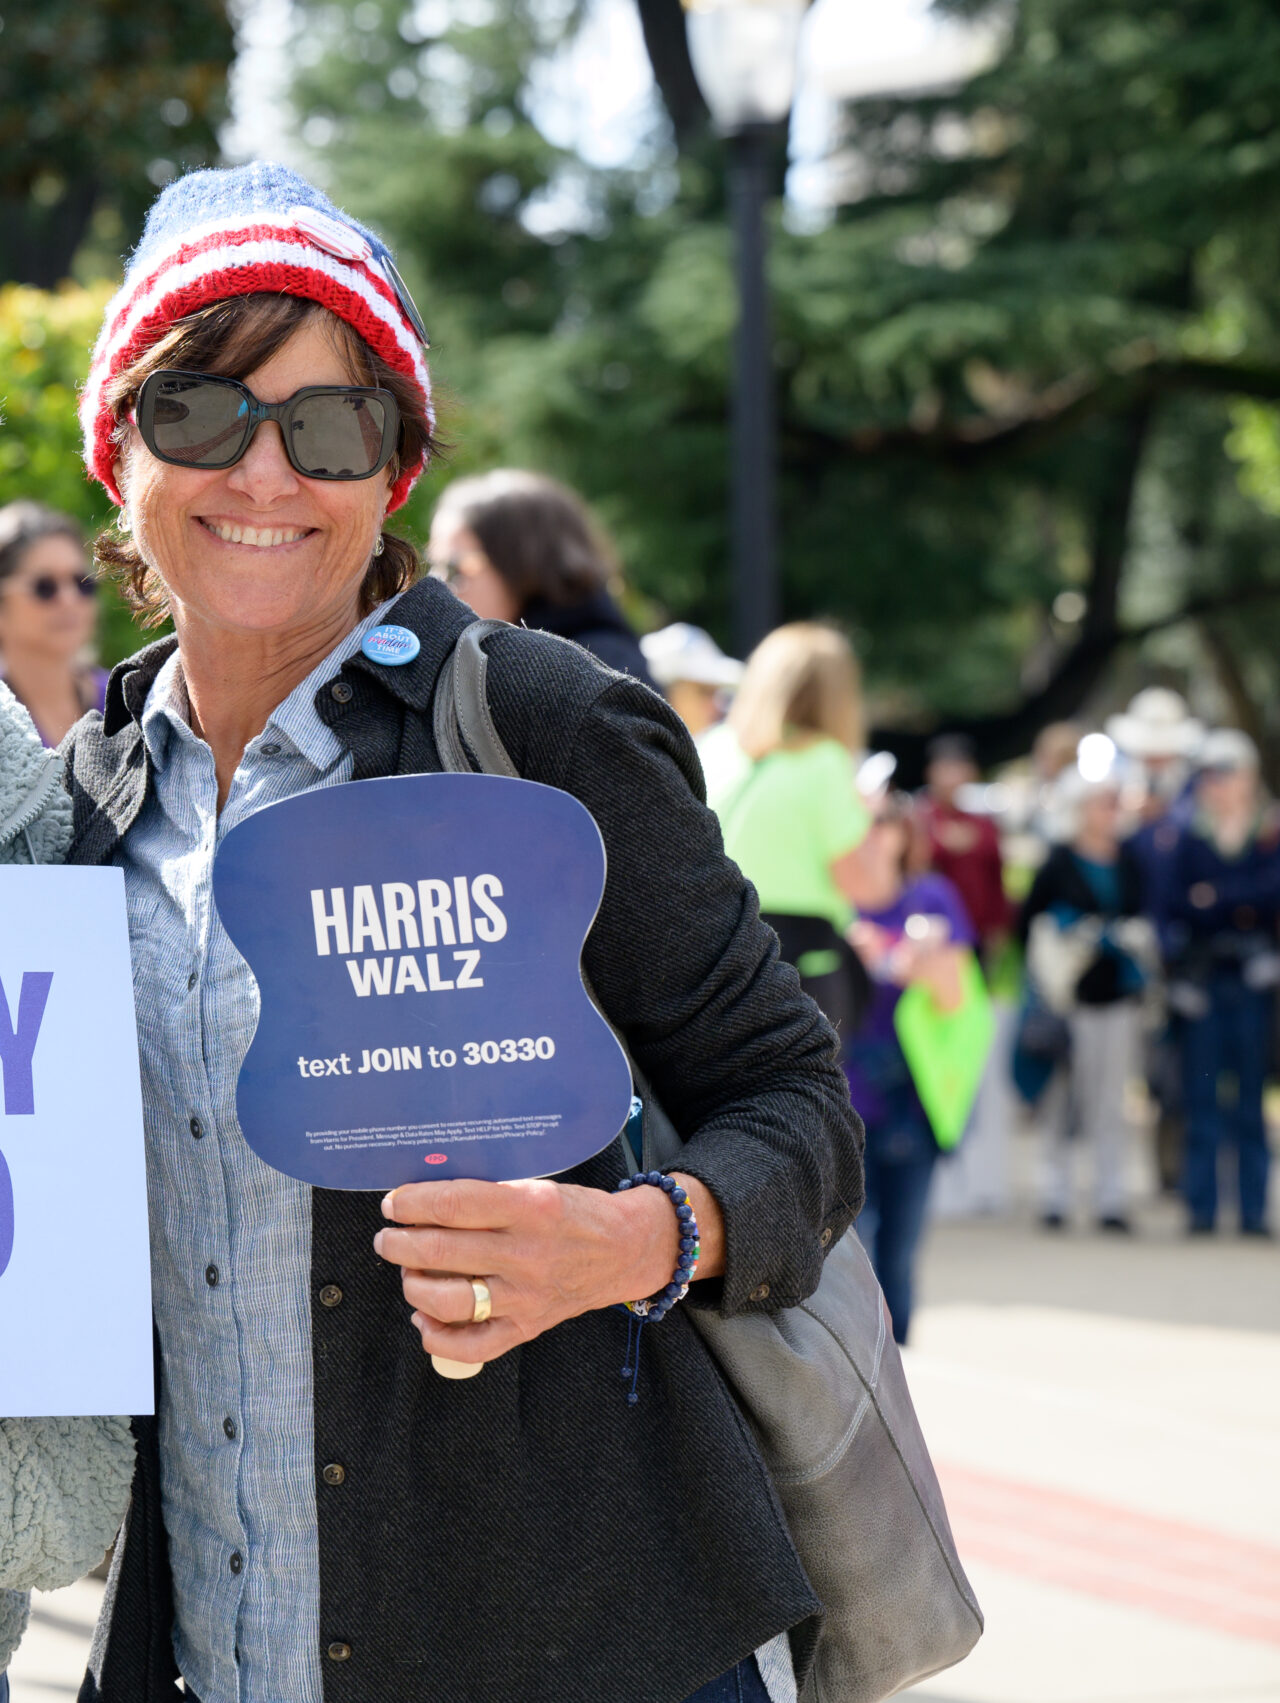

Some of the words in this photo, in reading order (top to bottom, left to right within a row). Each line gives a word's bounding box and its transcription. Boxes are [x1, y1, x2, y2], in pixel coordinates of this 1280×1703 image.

[374, 631, 410, 642] ABOUT
[377, 644, 401, 654] TIME
[310, 874, 508, 956] HARRIS
[345, 949, 484, 998] WALZ
[297, 1053, 352, 1078] text
[358, 1046, 422, 1074] JOIN
[428, 1046, 457, 1068] to
[462, 1036, 556, 1066] 30330
